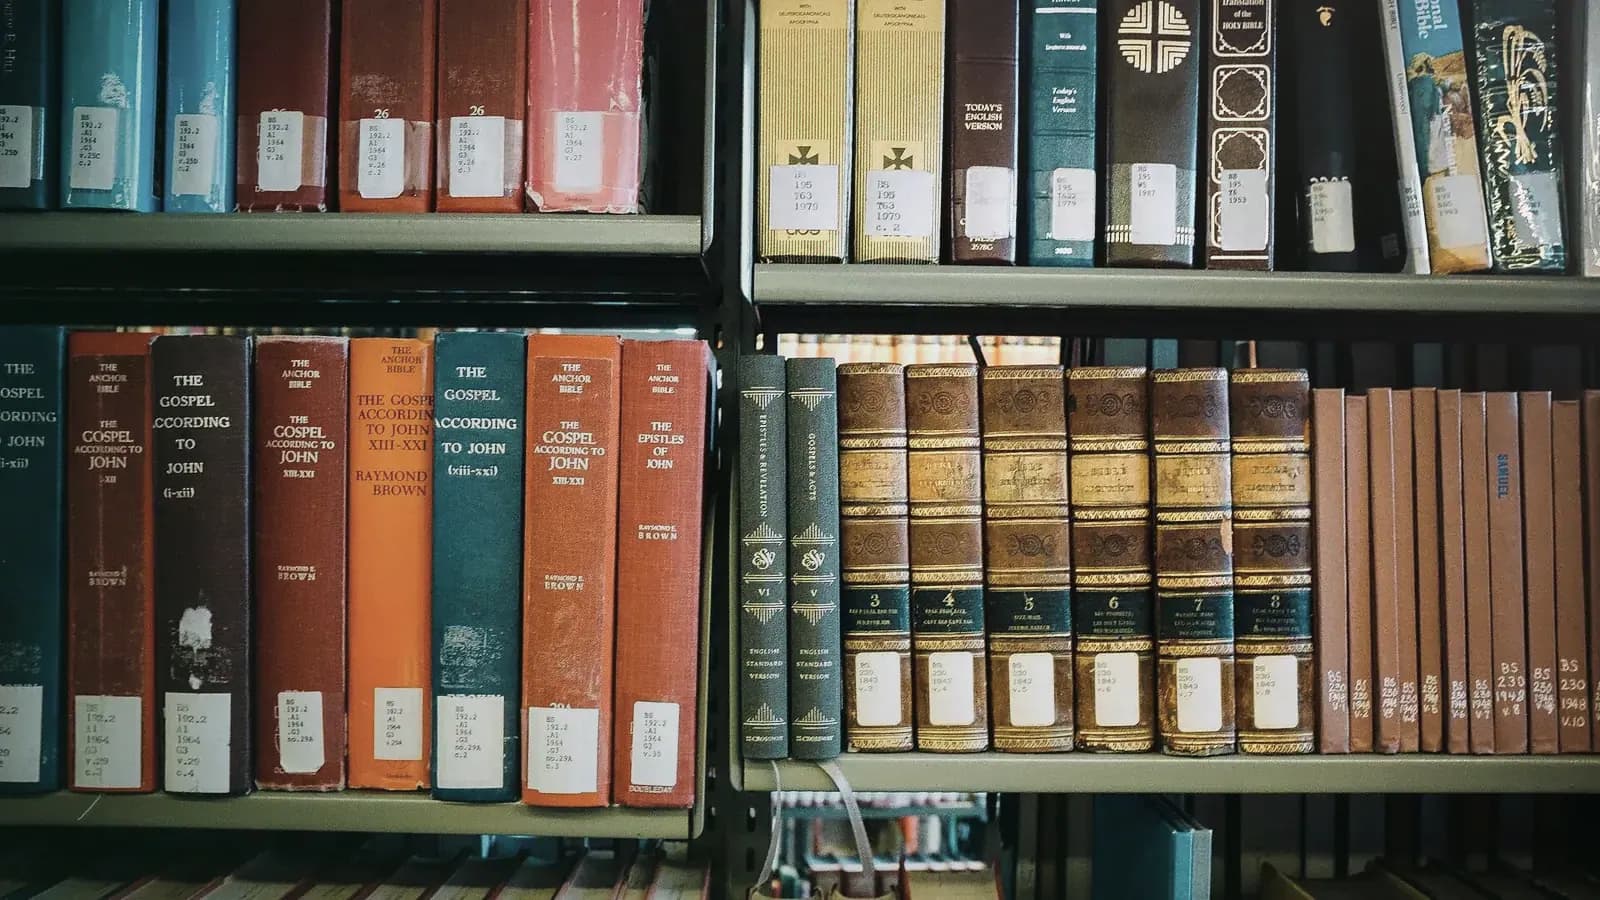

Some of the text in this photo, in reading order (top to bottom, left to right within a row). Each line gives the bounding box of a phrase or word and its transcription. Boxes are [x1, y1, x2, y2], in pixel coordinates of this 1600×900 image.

[1223, 22, 1241, 30] HOLY
[1052, 87, 1077, 96] Today's
[470, 105, 485, 116] 26
[965, 103, 1002, 112] TODAY'S
[374, 108, 390, 119] 26
[965, 113, 1002, 121] ENGLISH
[965, 122, 1003, 131] VERSION
[794, 181, 812, 189] 195
[876, 191, 896, 199] 195
[291, 359, 310, 368] THE
[381, 356, 423, 364] ANCHOR
[4, 363, 35, 374] THE
[99, 363, 118, 371] THE
[386, 365, 416, 374] BIBLE
[456, 366, 487, 378] THE
[561, 363, 581, 372] THE
[656, 364, 672, 372] THE
[88, 374, 128, 382] ANCHOR
[281, 370, 321, 378] ANCHOR
[551, 374, 591, 383] ANCHOR
[648, 375, 679, 383] ANCHOR
[173, 375, 204, 387] THE
[288, 380, 312, 389] BIBLE
[0, 387, 45, 399] OSPEL
[97, 384, 120, 393] BIBLE
[559, 385, 583, 394] BIBLE
[652, 386, 675, 394] BIBLE
[357, 394, 385, 406] THE
[444, 389, 500, 401] GOSPEL
[159, 395, 216, 408] GOSPEL
[0, 411, 57, 423] ORDING
[289, 415, 309, 424] THE
[358, 408, 435, 420] ACCORDIN
[99, 420, 118, 428] THE
[152, 416, 231, 429] CCORDING
[560, 421, 580, 429] THE
[650, 421, 673, 431] THE
[273, 425, 327, 439] GOSPEL
[366, 423, 430, 437] TO JOHN
[7, 435, 46, 447] JOHN
[82, 430, 135, 443] GOSPEL
[542, 431, 597, 445] GOSPEL
[638, 434, 684, 445] EPISTLES
[175, 438, 197, 450] TO
[265, 440, 336, 450] ACCORDING TO
[441, 442, 506, 455] TO JOHN
[74, 446, 144, 454] ACCORDING TO
[534, 446, 606, 456] ACCORDING TO
[653, 446, 669, 457] OF
[279, 450, 319, 464] JOHN
[0, 457, 29, 469] i-xii)
[88, 456, 128, 471] JOHN
[166, 462, 205, 475] JOHN
[548, 457, 589, 471] JOHN
[646, 459, 674, 469] JOHN
[355, 470, 428, 482] RAYMOND
[447, 465, 498, 477] (xiii-xxi)
[1497, 454, 1509, 499] SAMUEL
[551, 476, 585, 485] XIII-XXI
[163, 487, 196, 499] (i-xii)
[372, 485, 427, 497] BROWN
[638, 532, 678, 541] BROWN
[278, 572, 316, 581] BROWN
[544, 581, 584, 591] BROWN
[810, 588, 818, 597] V
[870, 593, 881, 607] 3
[942, 592, 956, 607] 4
[1024, 596, 1034, 611] 5
[1108, 596, 1119, 609] 6
[1194, 598, 1204, 612] 7
[1270, 595, 1281, 608] 8
[1501, 662, 1519, 674] BS
[1560, 658, 1579, 672] BS
[1534, 667, 1551, 680] BS
[1497, 675, 1526, 688] 230
[1560, 679, 1586, 690] 230
[1533, 681, 1553, 694] 230
[1495, 689, 1526, 702] 1948
[1561, 698, 1587, 711] 1948
